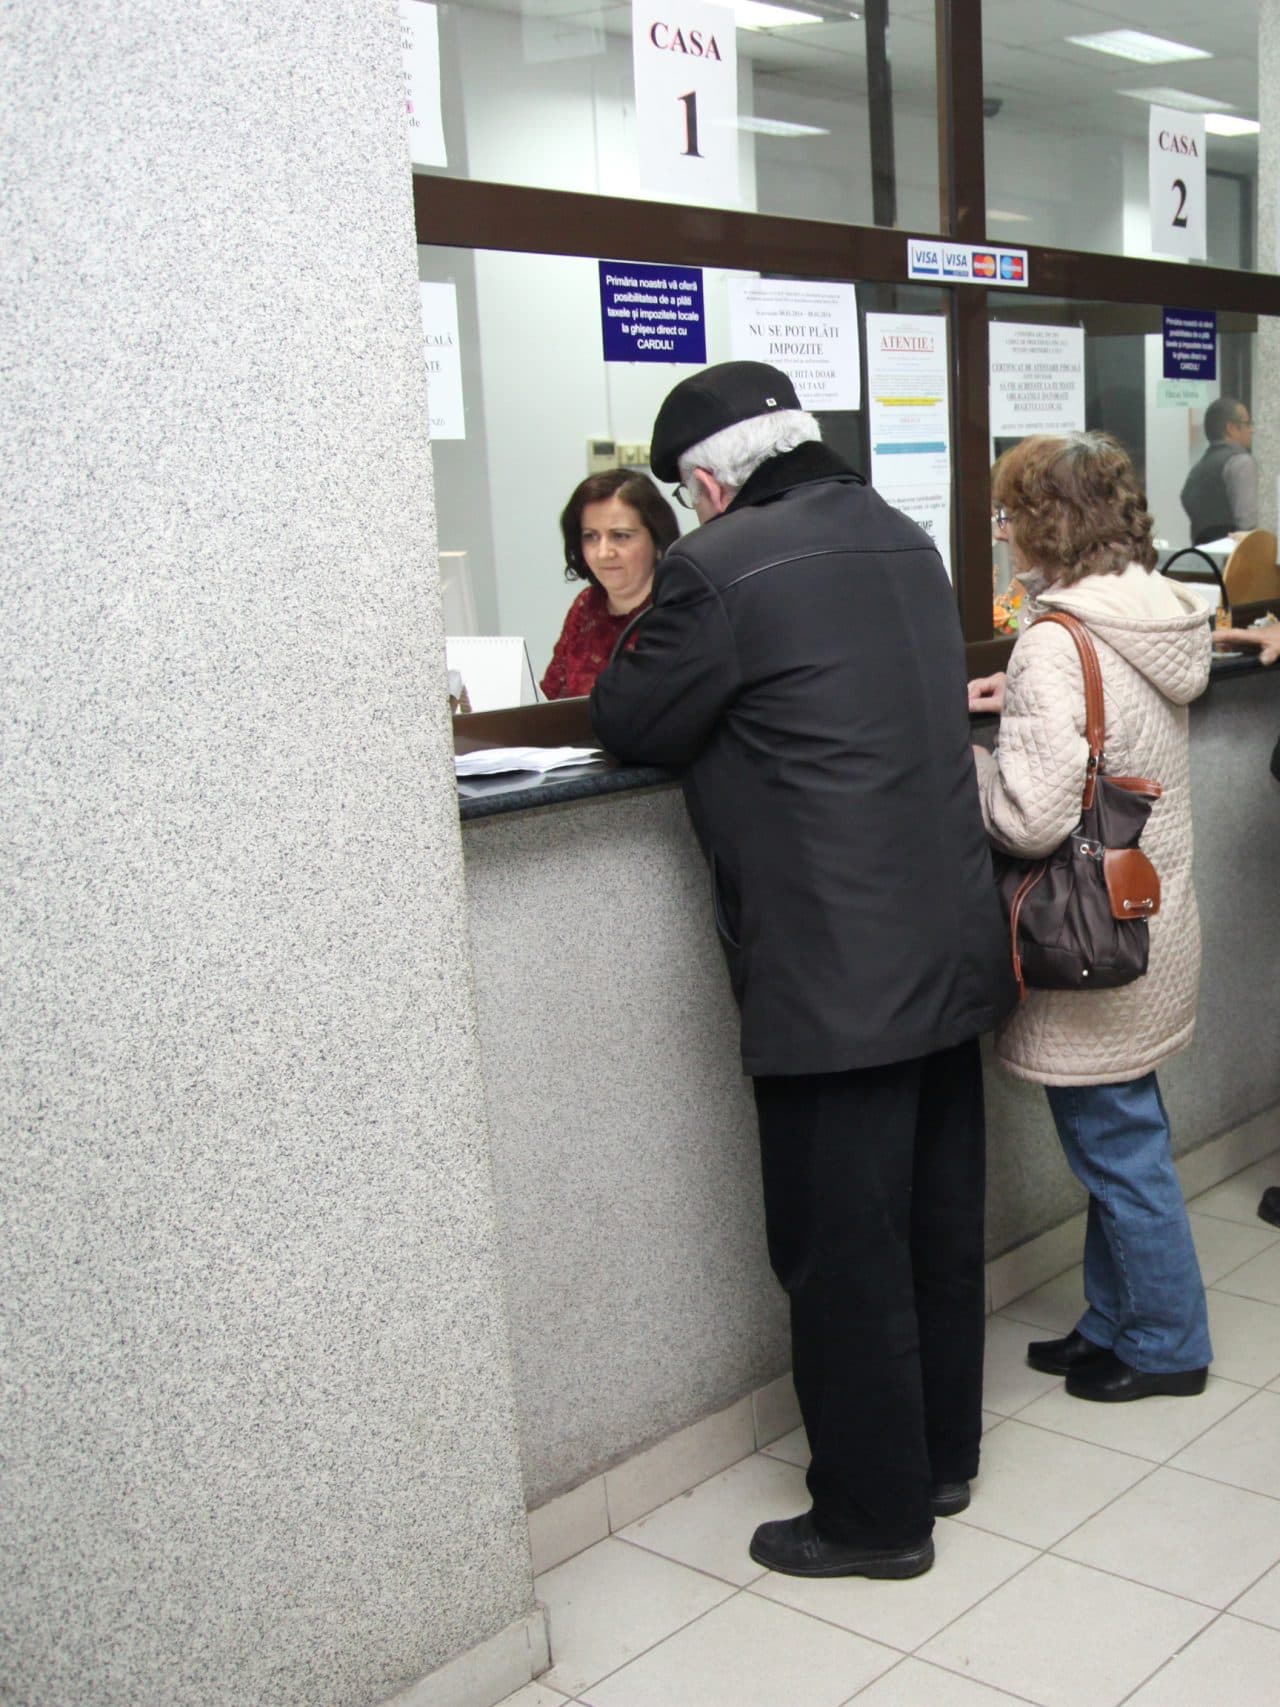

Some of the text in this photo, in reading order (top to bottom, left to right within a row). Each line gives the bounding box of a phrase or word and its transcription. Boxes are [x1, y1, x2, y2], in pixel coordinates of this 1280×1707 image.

[650, 21, 722, 62] CASA
[677, 90, 705, 159] 1
[1158, 129, 1199, 158] CASA
[1171, 178, 1188, 229] 2
[915, 250, 938, 265] VISA
[945, 253, 968, 267] VISA
[605, 274, 638, 288] Primăria
[613, 292, 658, 304] posibilitatea
[658, 294, 669, 305] de
[669, 297, 676, 306] a
[621, 322, 630, 334] la
[656, 324, 677, 336] direct
[677, 326, 688, 336] cu
[749, 323, 765, 337] NU
[767, 324, 783, 338] SE
[785, 324, 808, 338] POT
[636, 338, 675, 351] CARDUL!
[768, 343, 824, 356] IMPOZITE
[815, 369, 837, 380] DOAR
